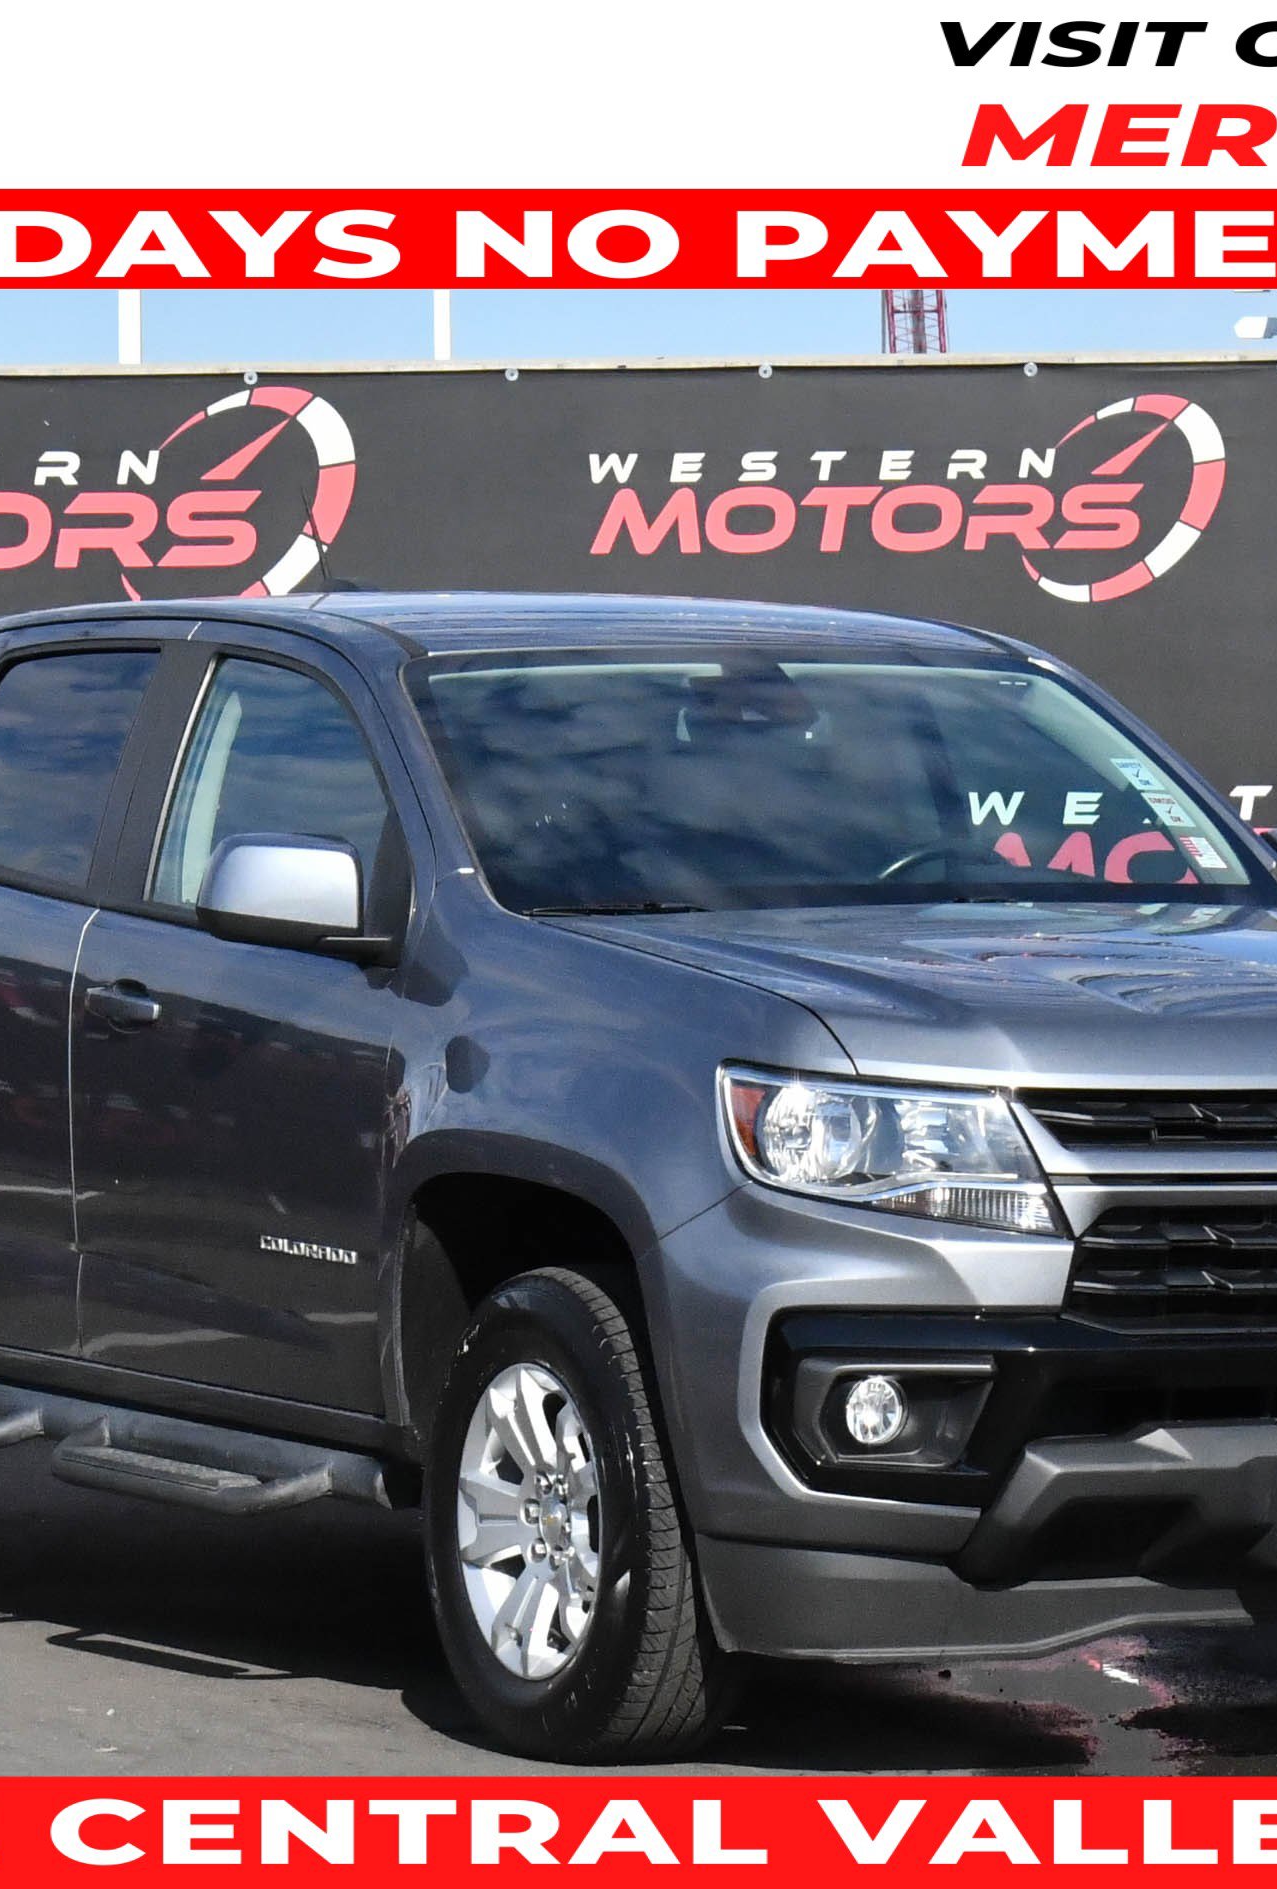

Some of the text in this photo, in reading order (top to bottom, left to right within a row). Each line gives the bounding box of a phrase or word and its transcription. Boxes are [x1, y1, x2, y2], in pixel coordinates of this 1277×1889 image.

[589, 448, 1056, 485] WESTERN
[591, 483, 1143, 555] MOTORS
[260, 1235, 358, 1265] COLORADO
